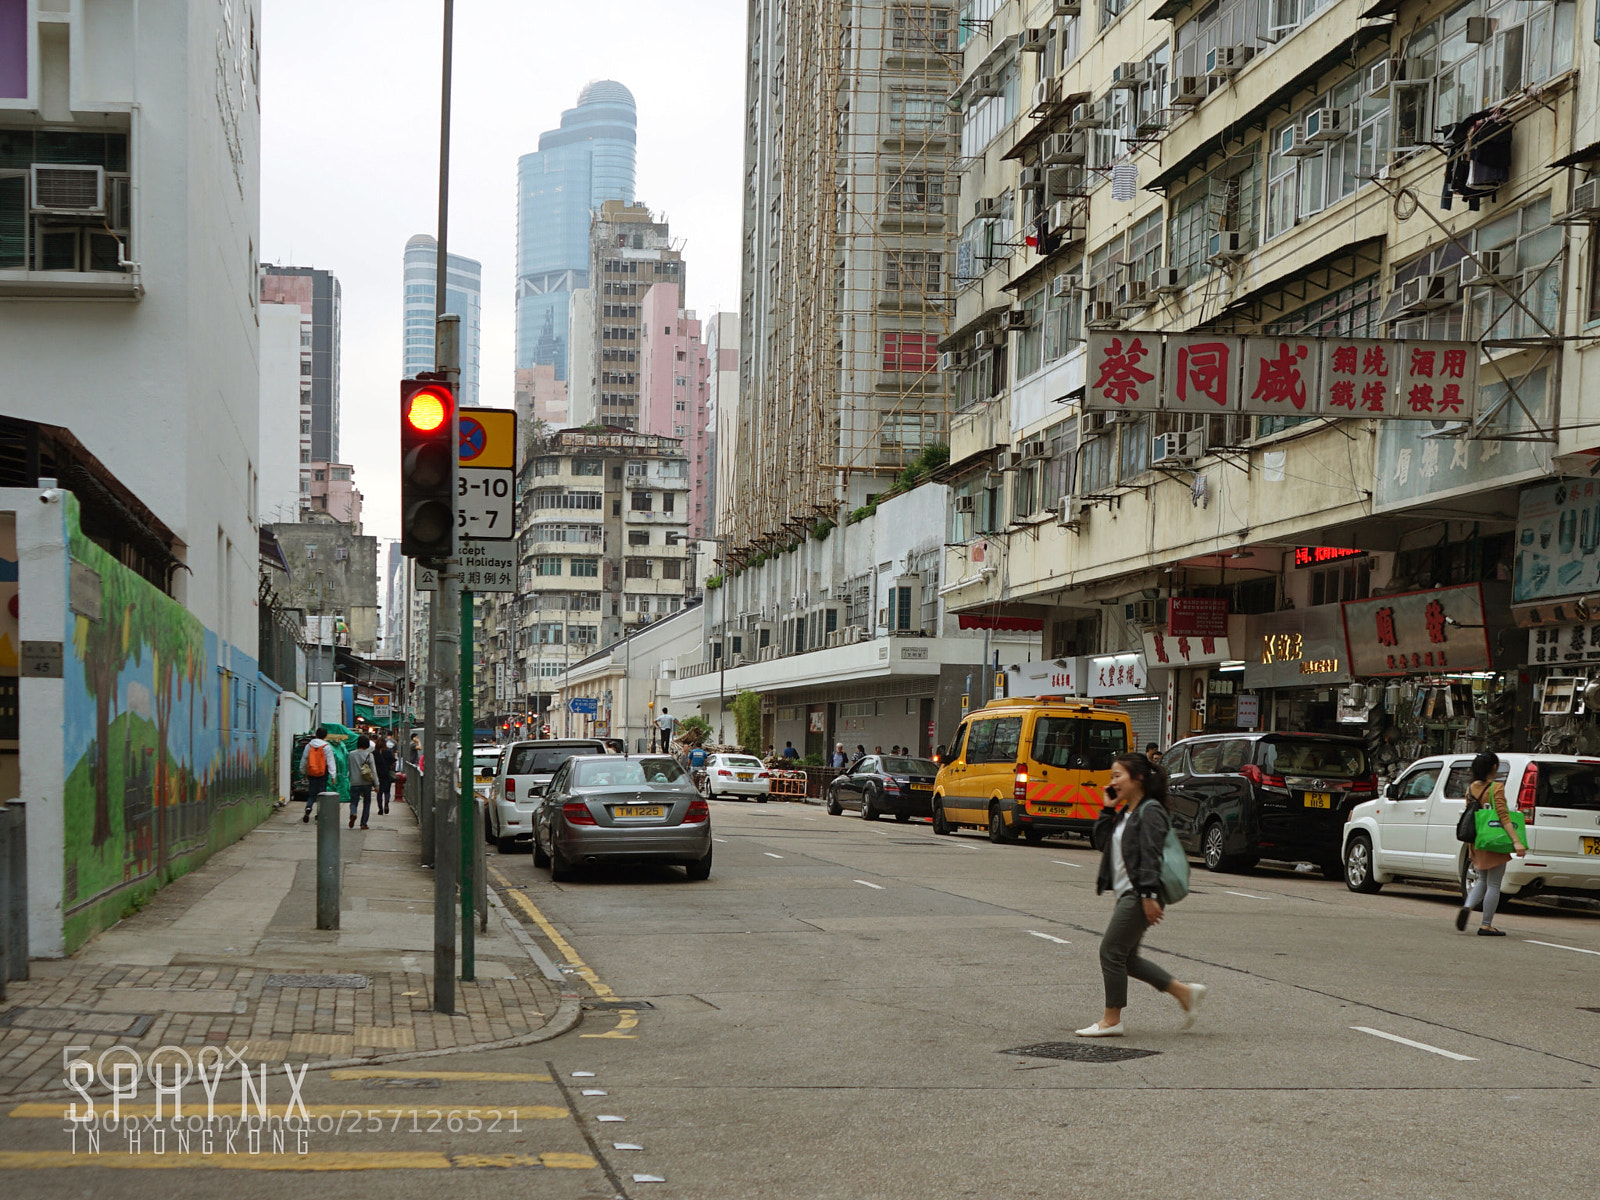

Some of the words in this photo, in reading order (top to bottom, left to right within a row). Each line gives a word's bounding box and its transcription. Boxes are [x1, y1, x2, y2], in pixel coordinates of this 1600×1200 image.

[466, 557, 513, 569] Holidays
[619, 807, 633, 816] TM
[635, 807, 659, 816] 1225
